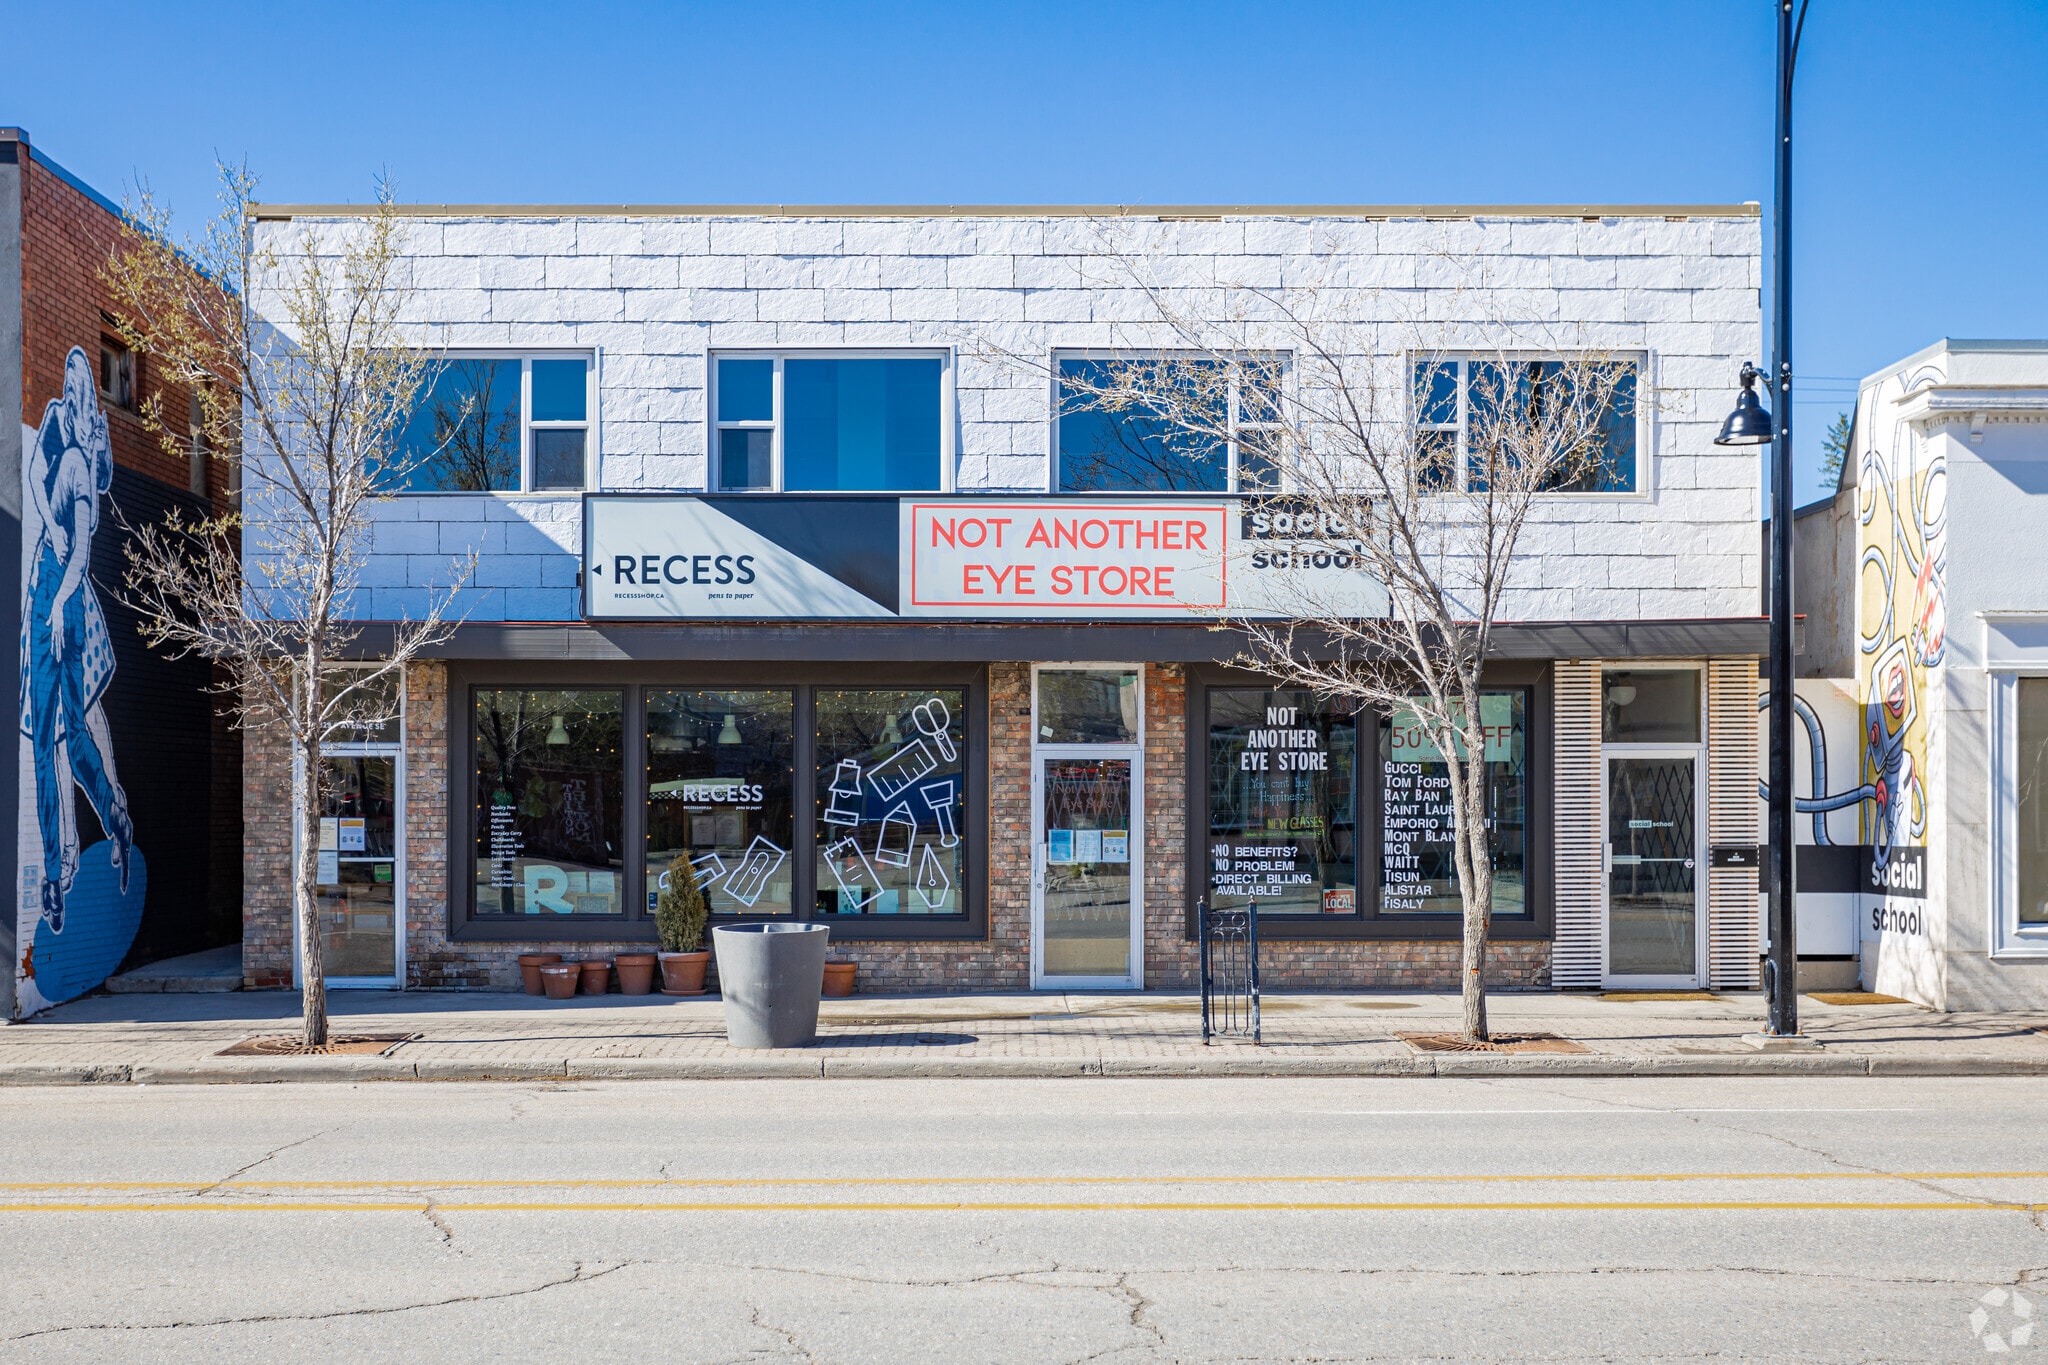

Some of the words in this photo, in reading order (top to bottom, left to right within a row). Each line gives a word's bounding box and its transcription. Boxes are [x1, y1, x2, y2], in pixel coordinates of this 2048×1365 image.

[932, 515, 1012, 550] NOT
[1025, 516, 1208, 550] ANOTHER
[1251, 544, 1362, 569] school
[614, 554, 756, 584] RECESS
[963, 564, 1036, 594] EYE
[1050, 565, 1175, 596] STORE
[1266, 706, 1298, 726] NOT
[340, 722, 373, 730] AVENUE
[1247, 730, 1317, 748] ANOTHER
[1241, 752, 1268, 770] EYE
[1278, 752, 1328, 770] STORE
[1384, 762, 1422, 774] GUCCI
[1295, 776, 1310, 791] buy
[1384, 774, 1412, 788] TOM
[1418, 776, 1450, 788] FORD
[683, 784, 764, 802] RECESS
[1056, 784, 1076, 794] Not
[1384, 788, 1409, 802] RAY
[1415, 788, 1440, 802] BAN
[1384, 802, 1420, 815] SAINT
[1426, 802, 1456, 815] LAUR
[1267, 818, 1288, 830] NEW
[1384, 816, 1439, 829] EMPORIO
[1384, 830, 1420, 842] MONT
[1426, 830, 1456, 842] BLAN
[1215, 844, 1230, 857] NO
[1235, 846, 1298, 857] BENEFITS?
[1215, 858, 1230, 871] NO
[1235, 861, 1295, 871] PROBLEM!
[1384, 856, 1420, 869] WAITT
[1384, 870, 1420, 882] TISUN
[1872, 852, 1922, 890] social
[1215, 874, 1260, 884] DIRECT
[1266, 874, 1312, 884] BILLING
[1216, 885, 1282, 896] AVAILABLE!
[1384, 882, 1432, 895] ALISTAR
[1326, 898, 1352, 908] LOCAL
[1384, 896, 1424, 909] FISALY
[1872, 902, 1921, 936] school
